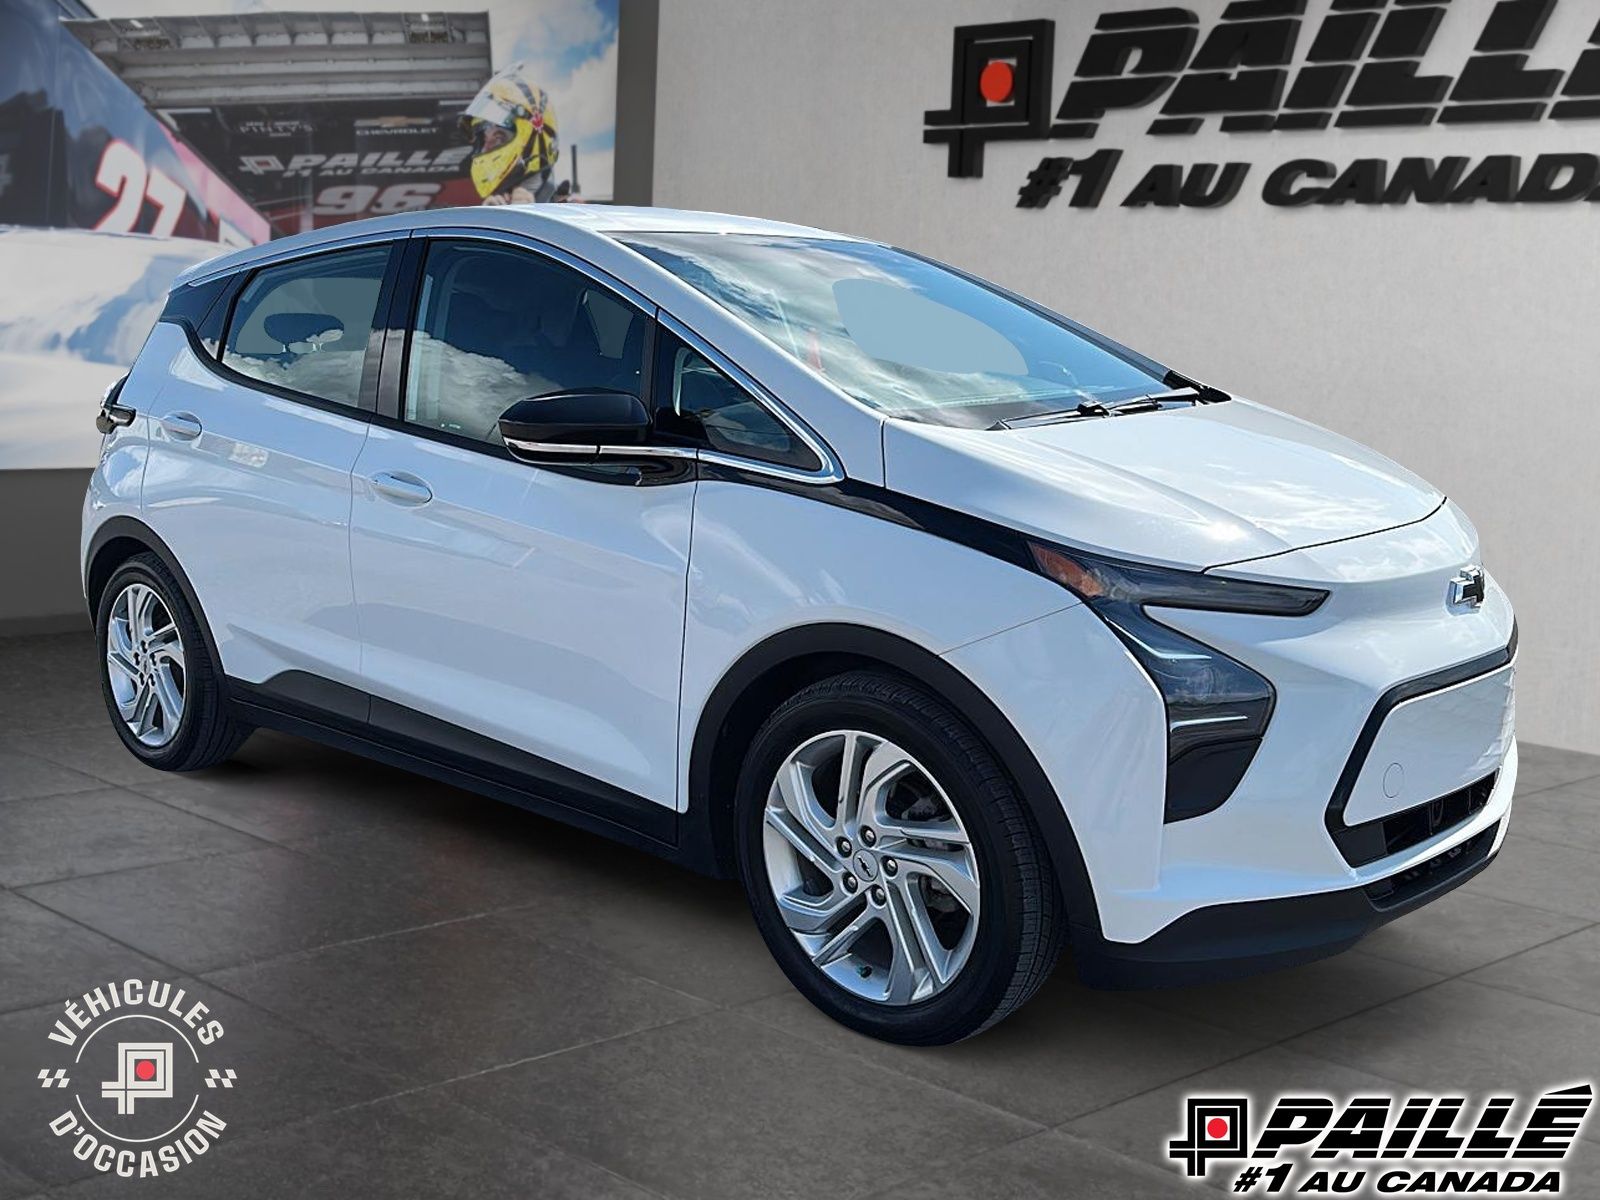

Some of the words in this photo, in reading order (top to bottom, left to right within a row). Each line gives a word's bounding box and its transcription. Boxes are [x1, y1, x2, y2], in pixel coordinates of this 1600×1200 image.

[356, 127, 438, 135] CHEVROLET
[319, 168, 353, 176] AU
[361, 165, 460, 174] CANADA
[1016, 148, 1123, 208] #1
[1120, 162, 1251, 208] AU
[1261, 153, 1600, 207] CANAD
[93, 138, 187, 238] 27
[313, 183, 441, 215] 96
